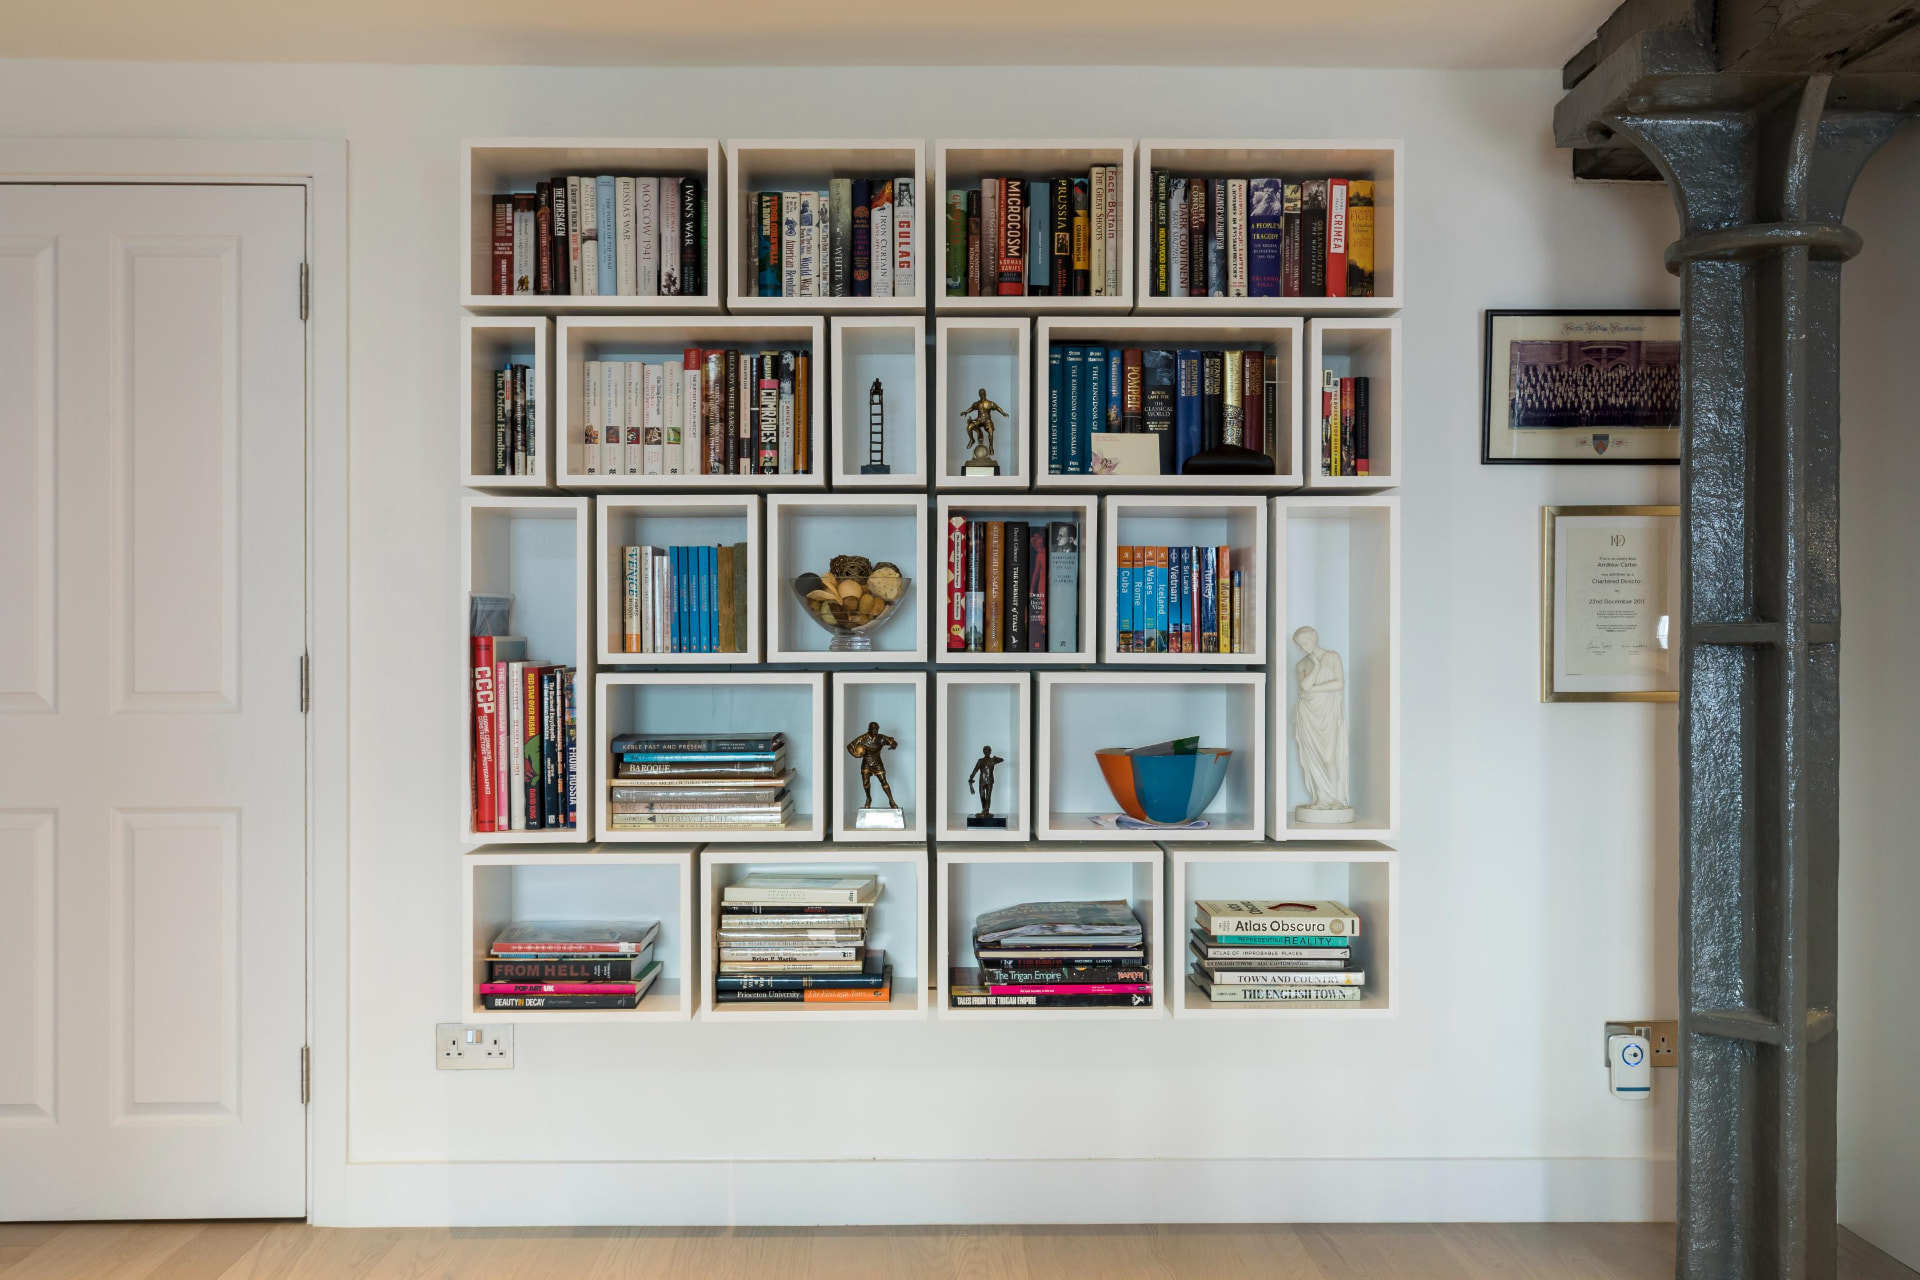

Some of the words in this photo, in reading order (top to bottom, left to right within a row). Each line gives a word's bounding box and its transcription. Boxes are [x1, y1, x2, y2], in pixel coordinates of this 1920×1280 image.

[1096, 171, 1104, 184] THE
[642, 184, 652, 236] MOSCOW
[685, 185, 694, 218] IVAN'S
[770, 196, 778, 221] TUDOR
[1058, 180, 1066, 228] PRUSSIA
[1096, 188, 1104, 210] GREAT
[1216, 185, 1224, 213] ALEXANDER
[556, 200, 566, 236] FORSAKEN
[1008, 181, 1020, 256] MICROCOSM
[1096, 214, 1104, 240] SHOOTS
[1180, 203, 1188, 228] DARK
[684, 222, 694, 247] WAR
[770, 223, 778, 264] CORNWALL
[899, 220, 910, 268] GULAG
[1216, 214, 1224, 250] SOLZHENITSYN
[1334, 214, 1343, 249] CRIMEA
[642, 240, 652, 260] 1941
[786, 240, 796, 268] American
[1180, 234, 1188, 290] CONTINENT
[800, 257, 812, 275] World
[800, 278, 812, 291] War
[497, 372, 506, 388] The
[1128, 367, 1140, 408] POMPEII
[497, 390, 506, 421] Oxford
[761, 390, 777, 442] COMRADES
[1070, 412, 1077, 420] OF
[1093, 421, 1099, 431] OF
[497, 424, 506, 469] Handbook
[626, 548, 638, 598] VENICE
[1170, 566, 1178, 602] Vietnam
[1203, 569, 1213, 598] Turkey
[475, 667, 494, 713] CCCP
[482, 756, 491, 794] PHOTOGRAPHED
[1235, 920, 1268, 932] Atlas
[1270, 920, 1325, 932] Obscura
[1284, 937, 1332, 946] REALITY
[494, 965, 539, 976] FROM
[544, 965, 590, 976] HELL
[994, 971, 1008, 982] The
[1010, 972, 1032, 982] Trigan
[1034, 971, 1062, 981] Empire
[957, 997, 972, 1005] TALES
[972, 997, 986, 1005] FROM
[987, 997, 997, 1005] THE
[997, 997, 1016, 1005] TRIGAN
[1017, 997, 1036, 1005] EMPIRE
[1242, 989, 1264, 999] THE
[1266, 989, 1312, 999] ENGLISH
[1314, 989, 1346, 999] TOWN
